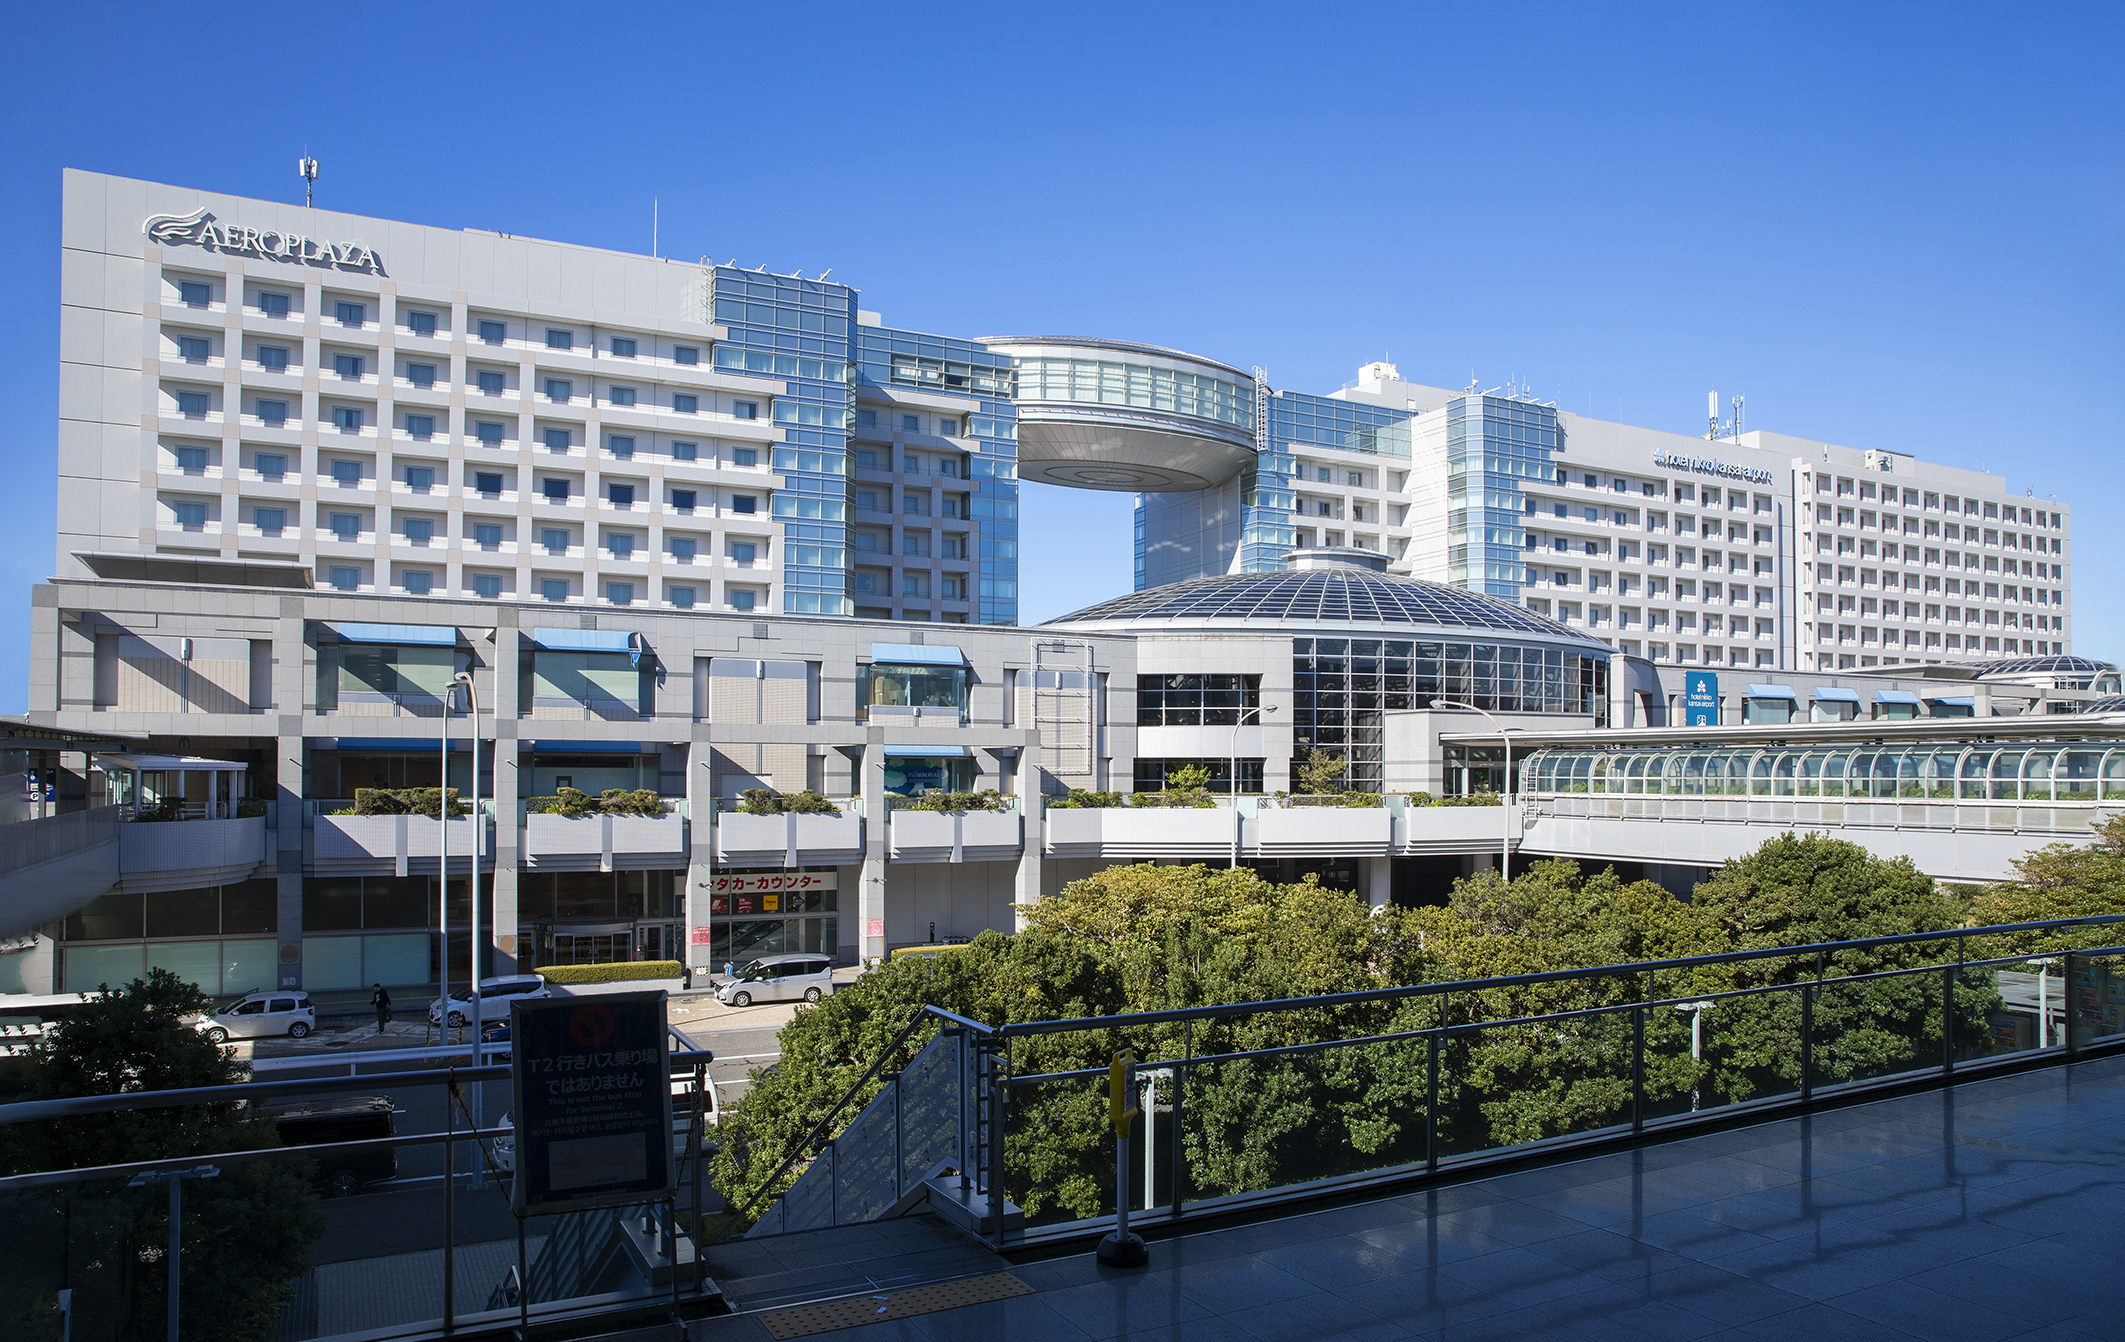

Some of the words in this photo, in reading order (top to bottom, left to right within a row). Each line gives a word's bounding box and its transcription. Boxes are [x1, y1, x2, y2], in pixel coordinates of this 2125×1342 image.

[195, 220, 380, 269] AEROPLAZA
[528, 1048, 658, 1074] T2行きバス乗り場
[545, 1072, 644, 1095] ではありません
[548, 1098, 566, 1106] This
[567, 1096, 575, 1104] is
[592, 1094, 606, 1102] the
[607, 1092, 622, 1100] bus
[624, 1090, 642, 1099] stop
[566, 1106, 578, 1114] for
[580, 1102, 615, 1113] Terminal
[531, 1128, 553, 1137] 여기는
[588, 1123, 603, 1132] 버스
[604, 1120, 631, 1130] 승강장이
